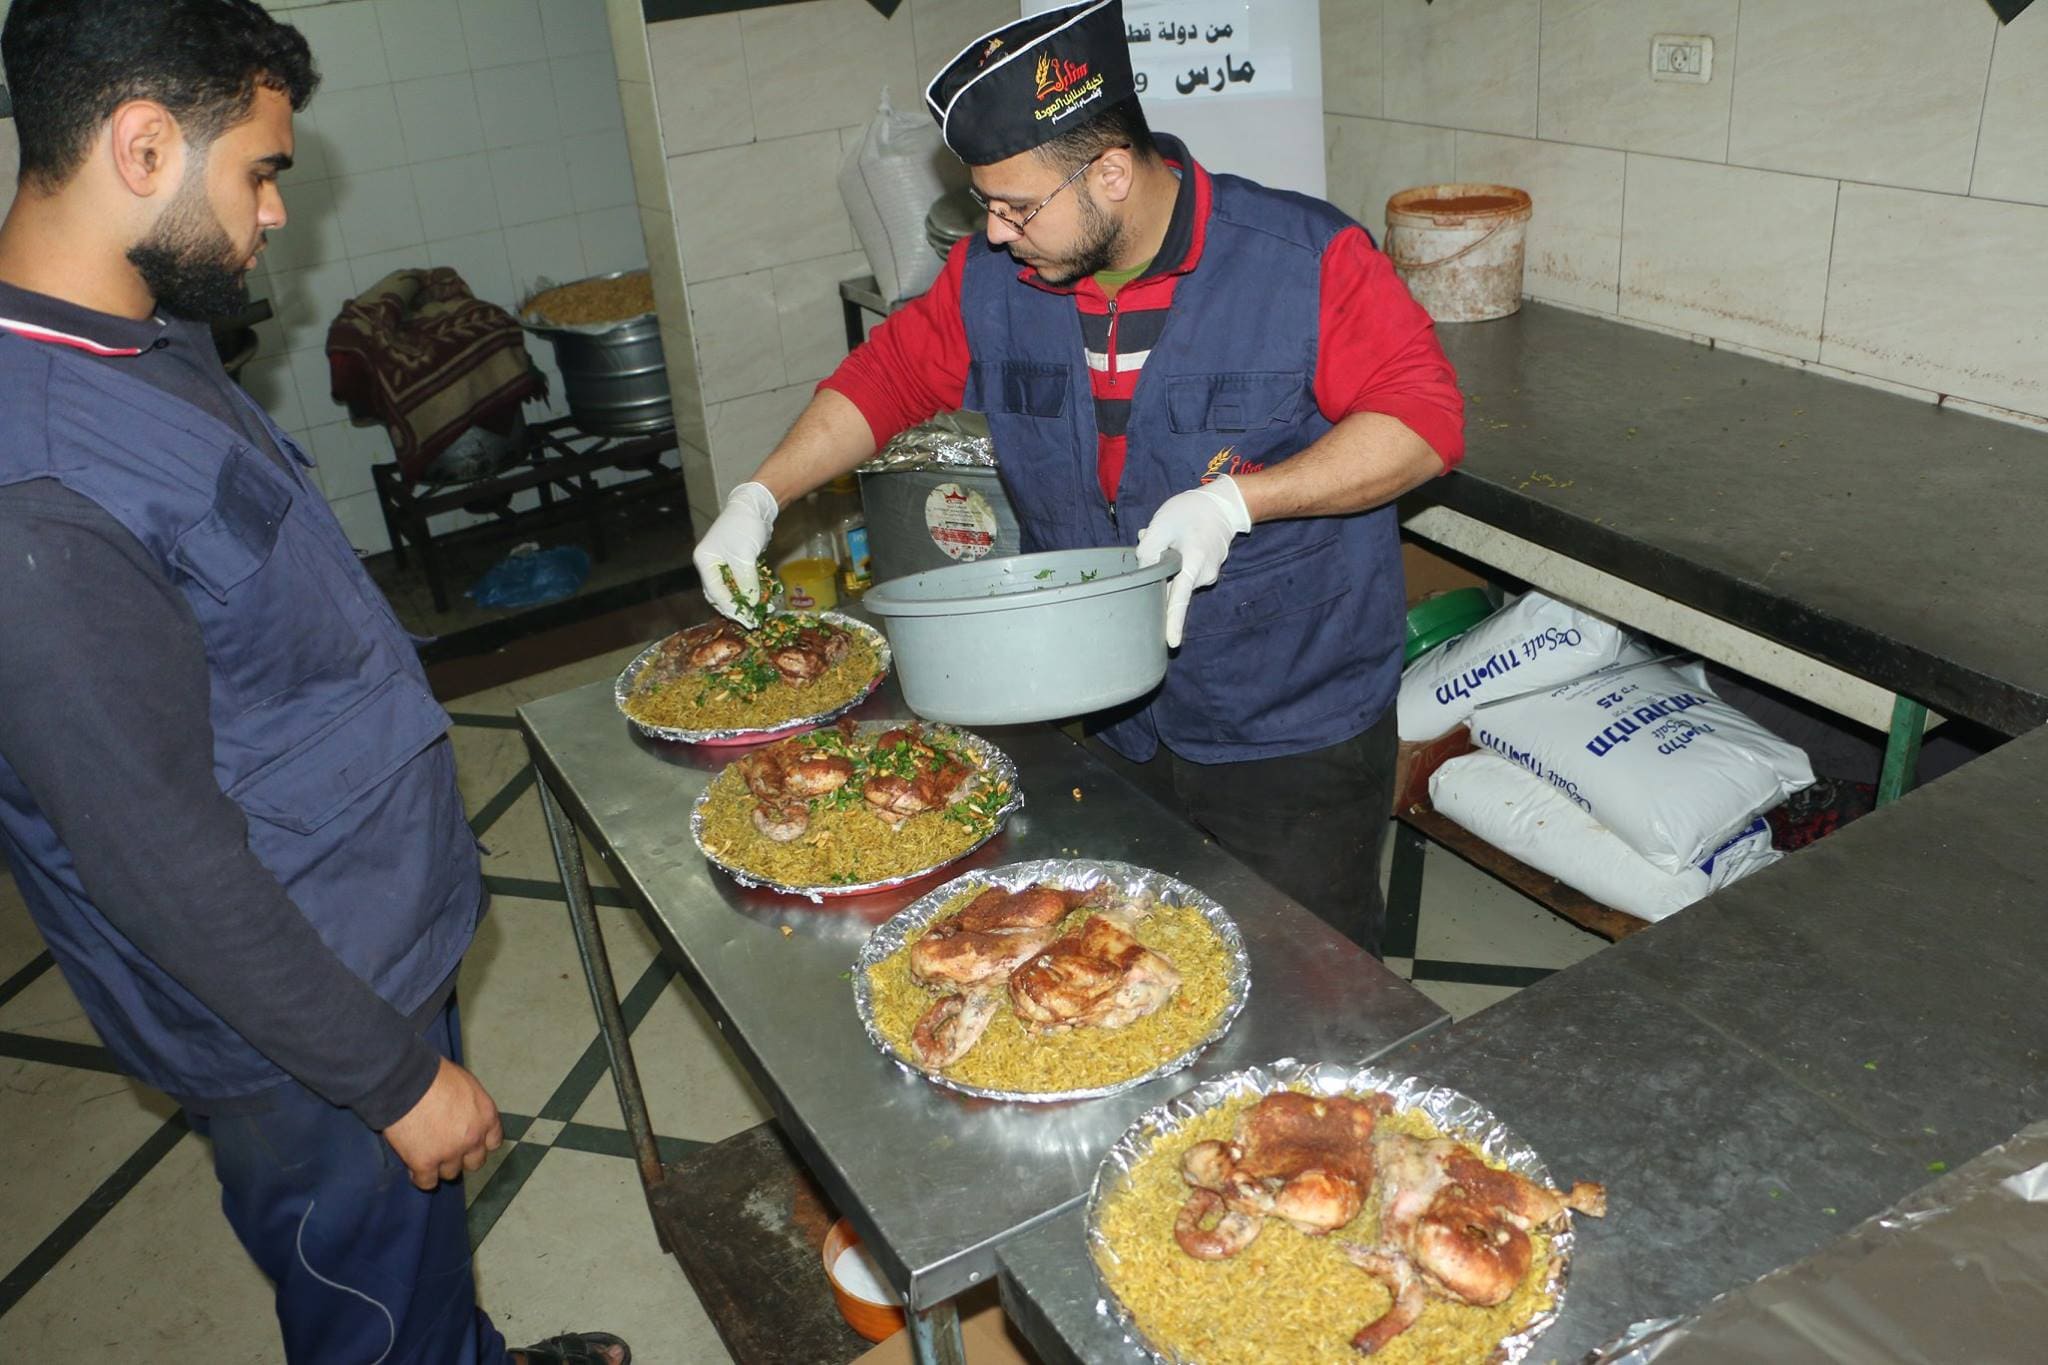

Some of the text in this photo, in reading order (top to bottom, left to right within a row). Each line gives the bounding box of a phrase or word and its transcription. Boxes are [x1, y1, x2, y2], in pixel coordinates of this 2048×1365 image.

[1126, 21, 1233, 45] من دولة قط
[1176, 54, 1255, 94] مارس
[1522, 627, 1582, 660] OzSalt
[1596, 692, 1623, 709] 25
[1585, 717, 1641, 757] מלח
